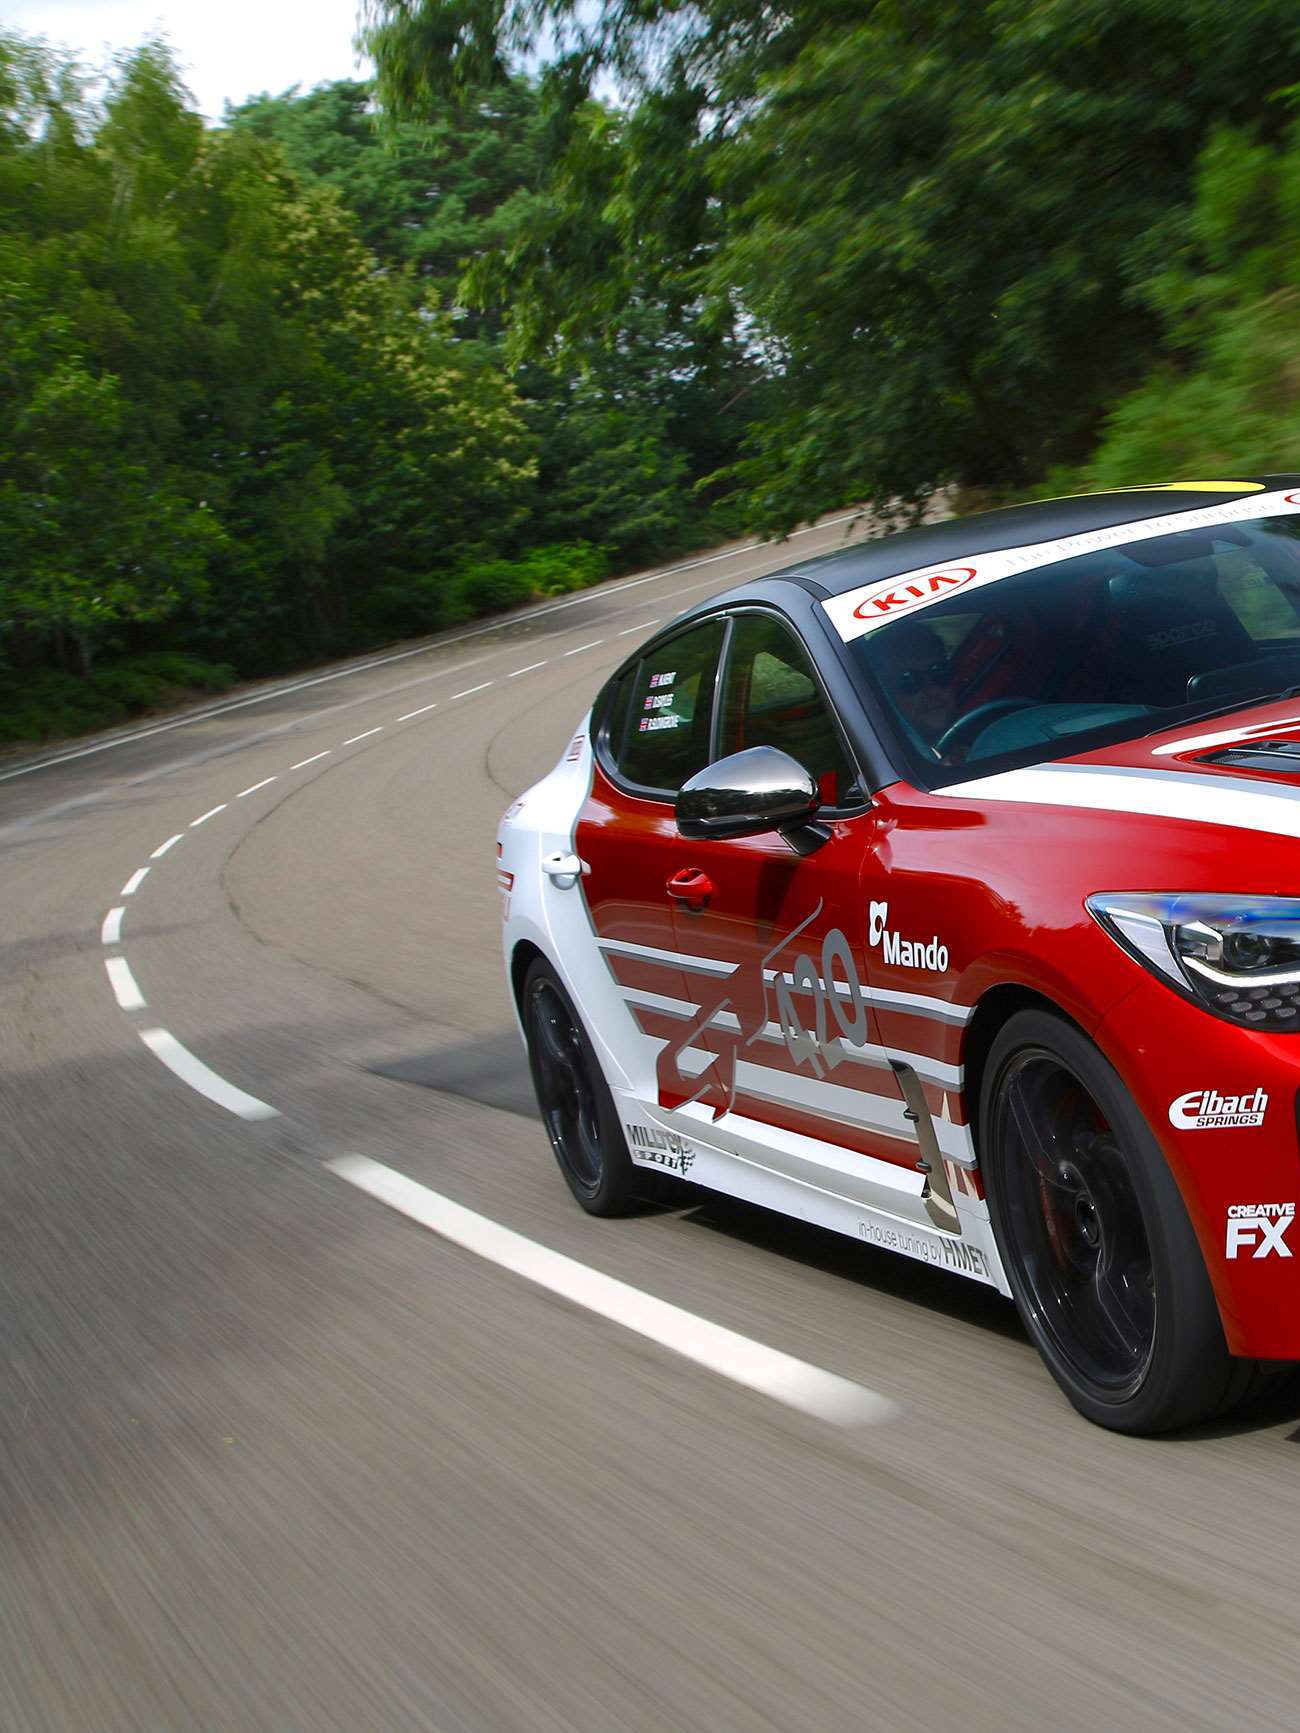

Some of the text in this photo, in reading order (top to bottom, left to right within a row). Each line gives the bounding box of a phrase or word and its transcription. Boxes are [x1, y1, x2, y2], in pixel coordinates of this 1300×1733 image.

[870, 572, 962, 613] KIA
[882, 930, 949, 973] Mando
[1168, 1087, 1269, 1122] Eibach
[1196, 1113, 1259, 1128] SPRINGS
[1227, 1202, 1296, 1218] CREATIVE
[856, 1216, 897, 1247] in-house
[899, 1232, 928, 1262] tuning
[929, 1237, 942, 1266] by
[1225, 1215, 1295, 1260] FX
